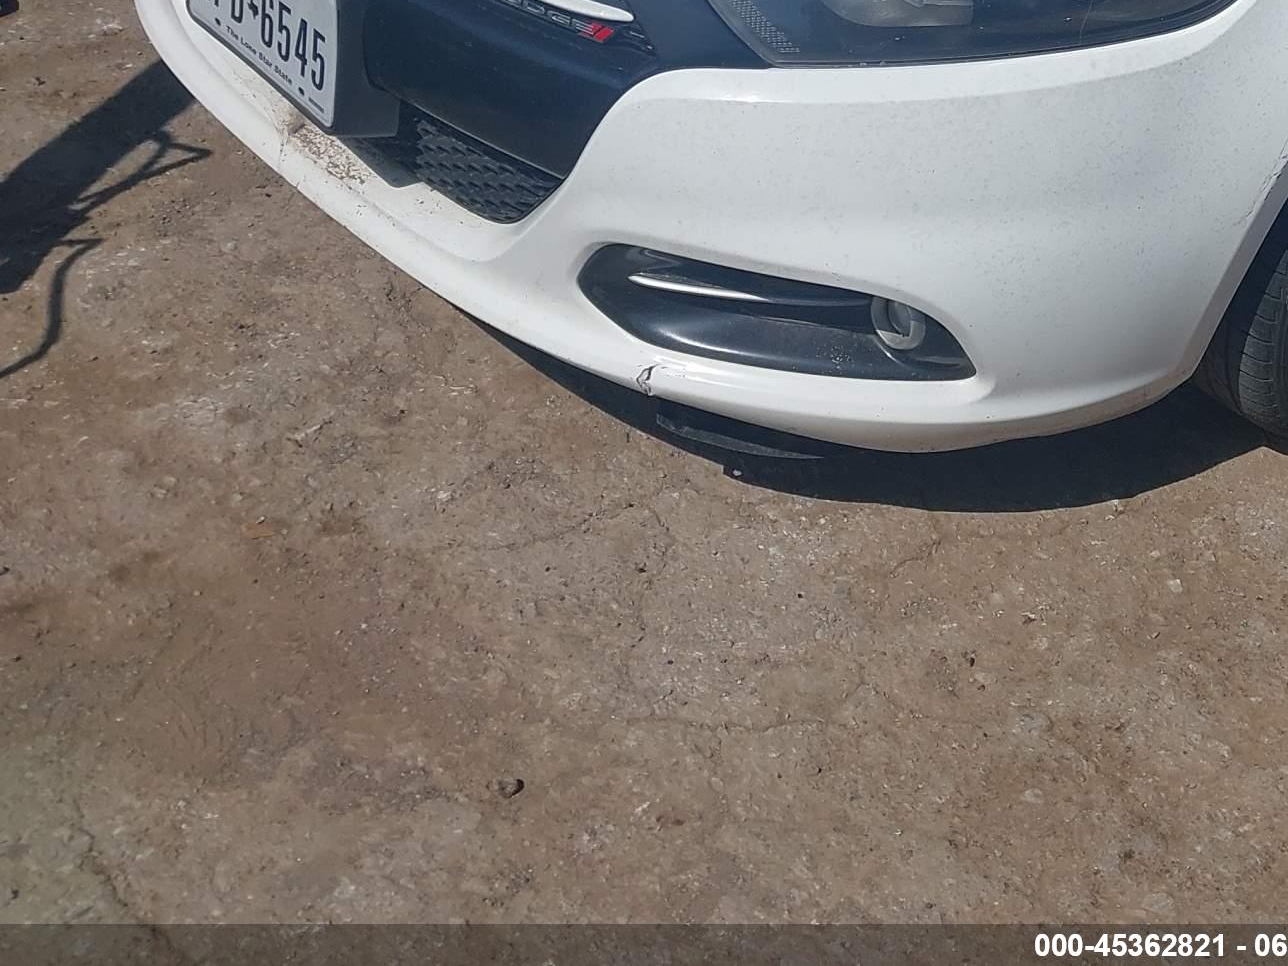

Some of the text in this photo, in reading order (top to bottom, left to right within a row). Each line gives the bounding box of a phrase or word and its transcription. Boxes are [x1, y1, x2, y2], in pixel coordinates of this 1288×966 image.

[225, 25, 293, 85] The Lone Star State
